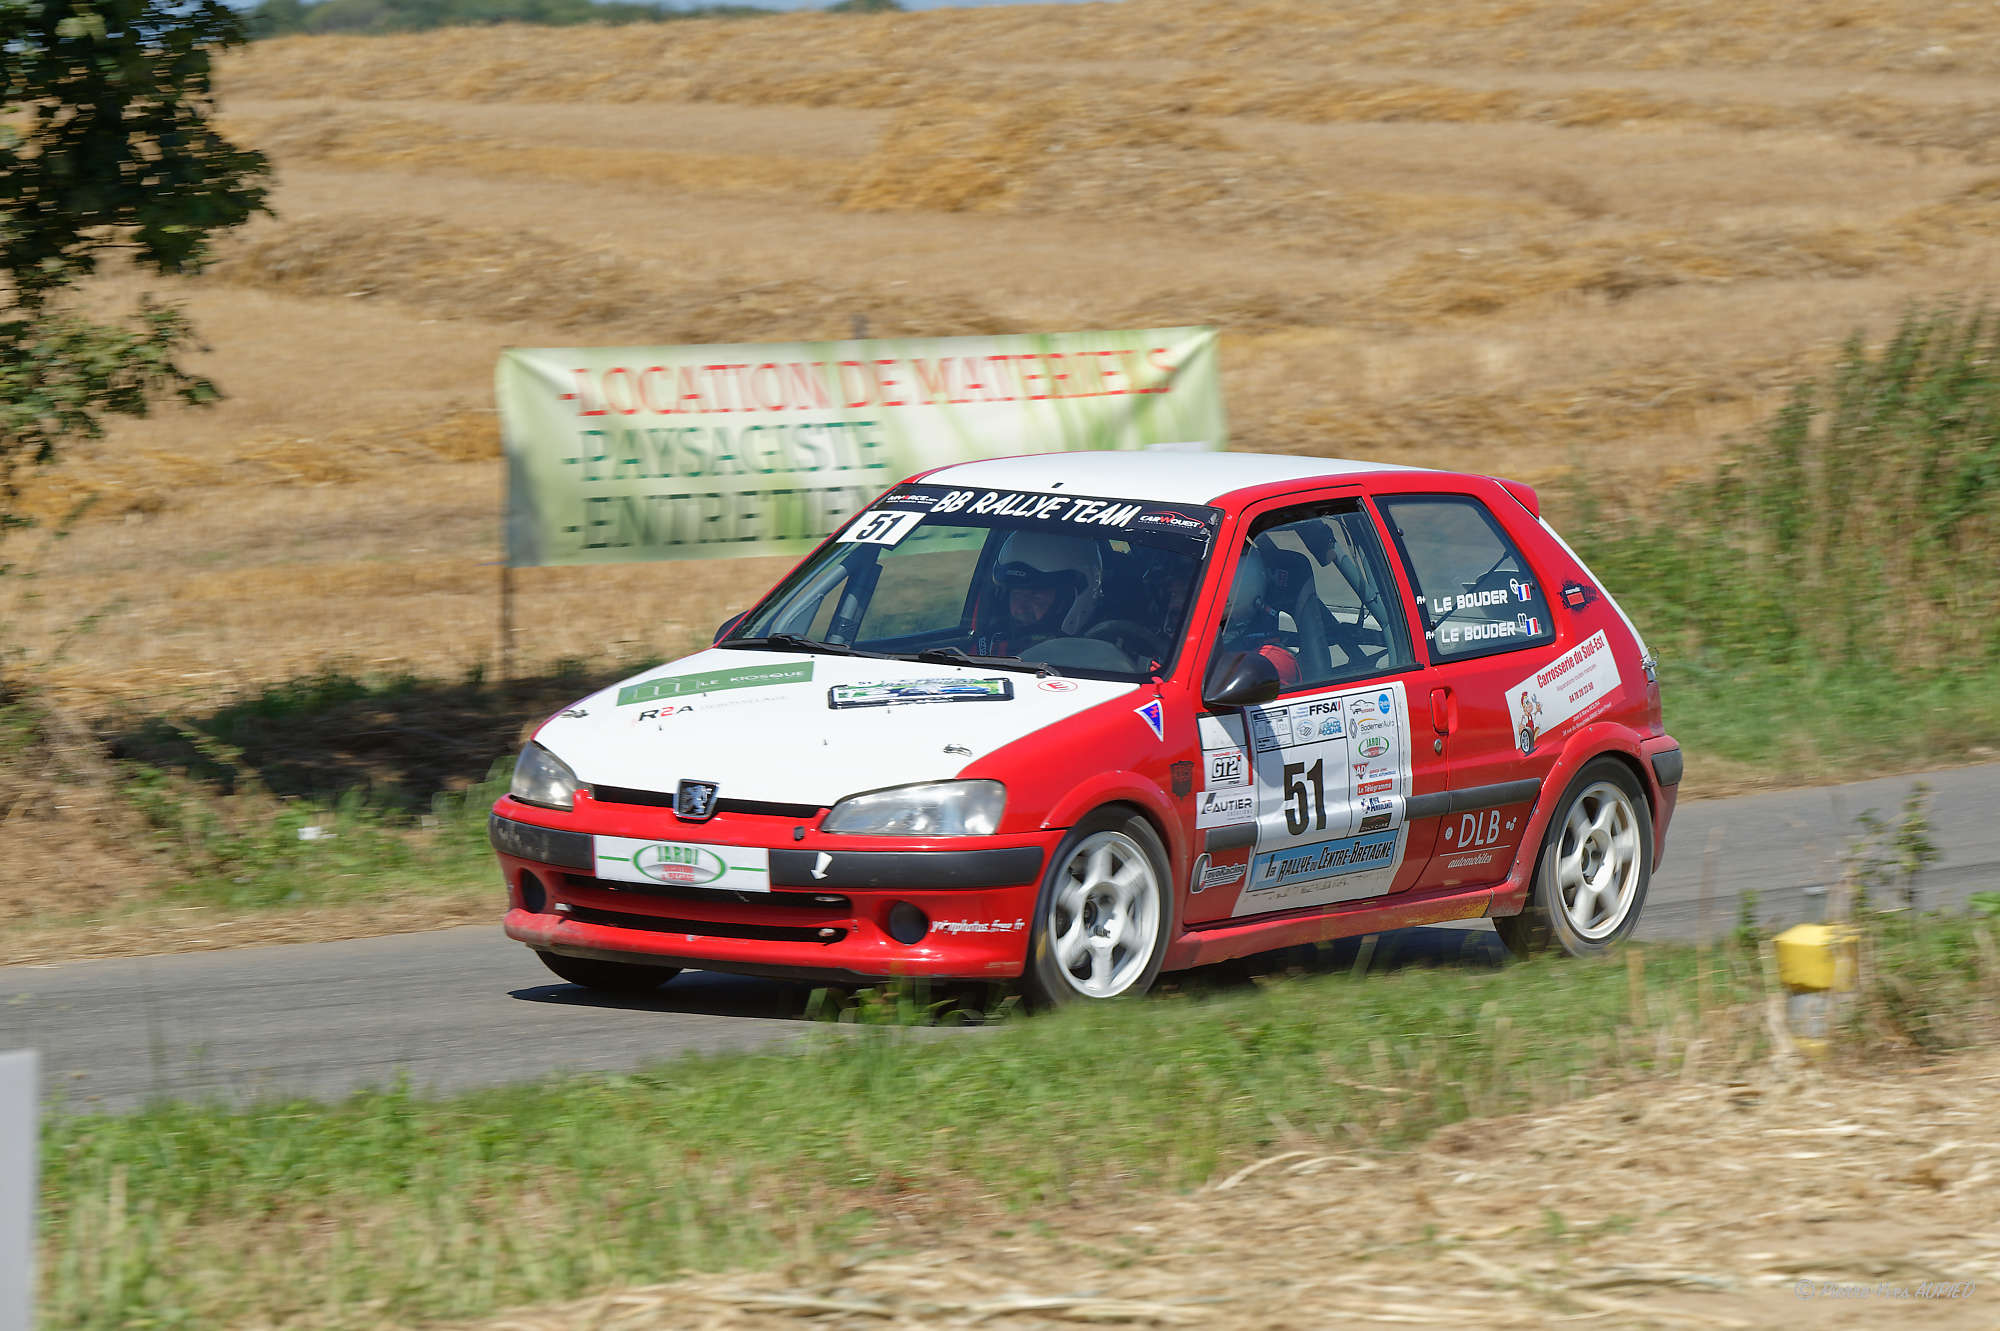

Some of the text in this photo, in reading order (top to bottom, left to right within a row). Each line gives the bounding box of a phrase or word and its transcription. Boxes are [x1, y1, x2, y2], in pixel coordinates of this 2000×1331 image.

[836, 360, 905, 408] DE
[931, 491, 1142, 528] BB RALLYE TEAM
[856, 513, 907, 540] 51
[1434, 596, 1453, 613] LE
[1456, 589, 1508, 610] BOUDER
[1442, 627, 1460, 643] LE
[1464, 621, 1516, 641] BOUDER
[729, 670, 805, 683] KIOSQUE
[1536, 656, 1576, 689] Carrosserie
[1573, 650, 1584, 665] du
[1581, 635, 1606, 659] Sud-Est
[1309, 701, 1338, 716] FFSA
[1283, 758, 1327, 836] 51
[1457, 809, 1501, 849] DLB
[1277, 855, 1313, 883] RALLYE
[1317, 841, 1394, 870] CENTRE-BRETAGNE
[1447, 852, 1493, 869] automobiles
